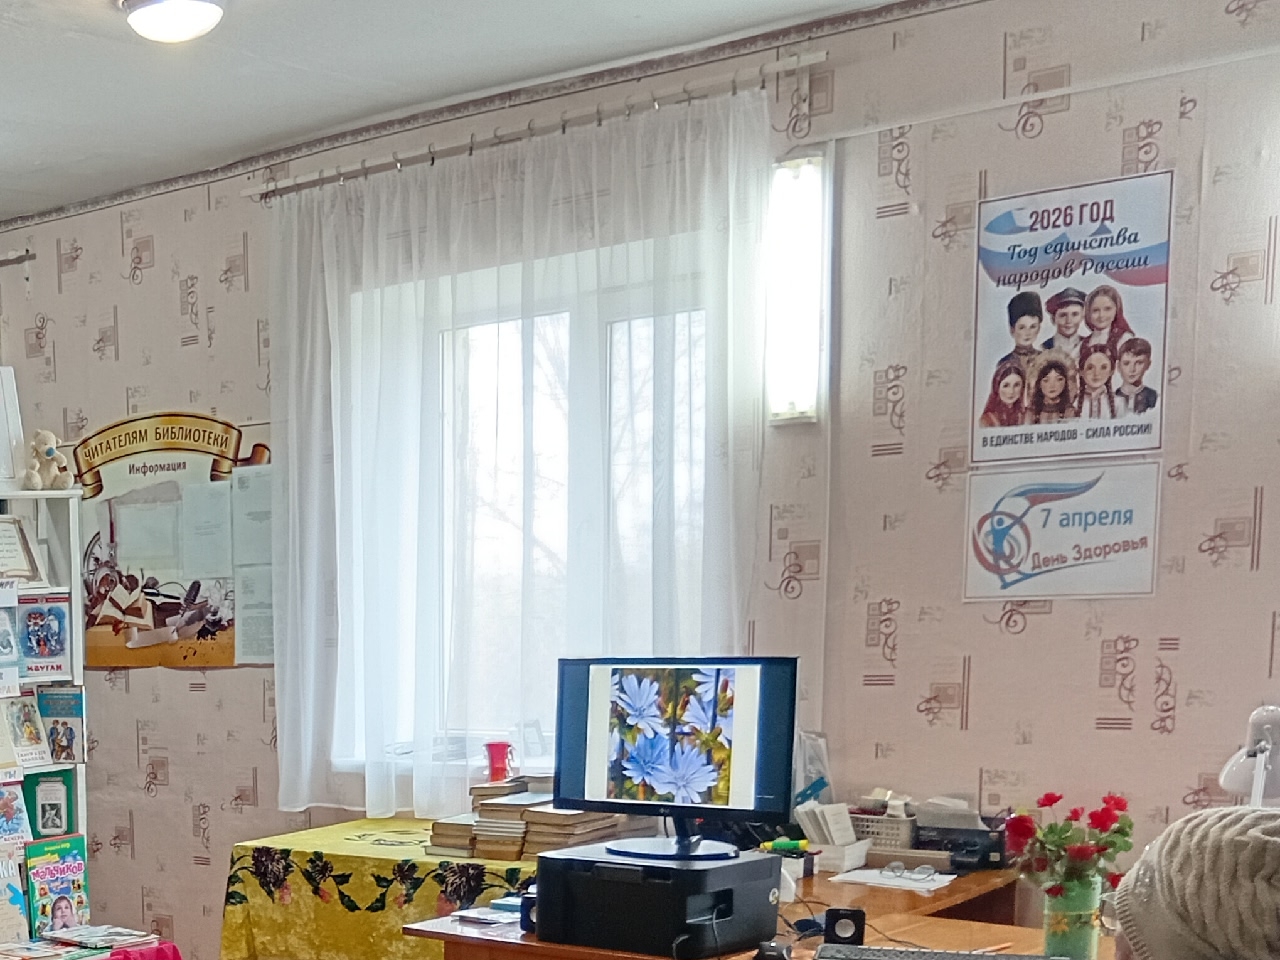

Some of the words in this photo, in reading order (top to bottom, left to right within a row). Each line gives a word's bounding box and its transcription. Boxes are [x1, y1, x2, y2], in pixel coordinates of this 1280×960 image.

[1029, 205, 1074, 232] 2026
[1079, 199, 1115, 225] ГОД
[1008, 244, 1039, 264] Год
[1044, 227, 1140, 261] единства
[996, 258, 1075, 291] народов
[1079, 254, 1150, 276] России
[84, 429, 148, 461] ЧИТАТЕЛЯМ
[155, 426, 229, 450] БИБЛИОТЕКИ
[982, 437, 989, 448] В
[989, 433, 1035, 447] ЕДИНСТВЕ
[1036, 429, 1078, 442] НАРОДОВ
[1085, 427, 1111, 439] СИЛА
[1113, 424, 1153, 436] РОССИИ!
[128, 461, 187, 477] Информация
[1040, 508, 1052, 528] 7
[1059, 509, 1134, 532] апреля
[1031, 552, 1068, 571] День
[1072, 536, 1149, 561] Здоровья
